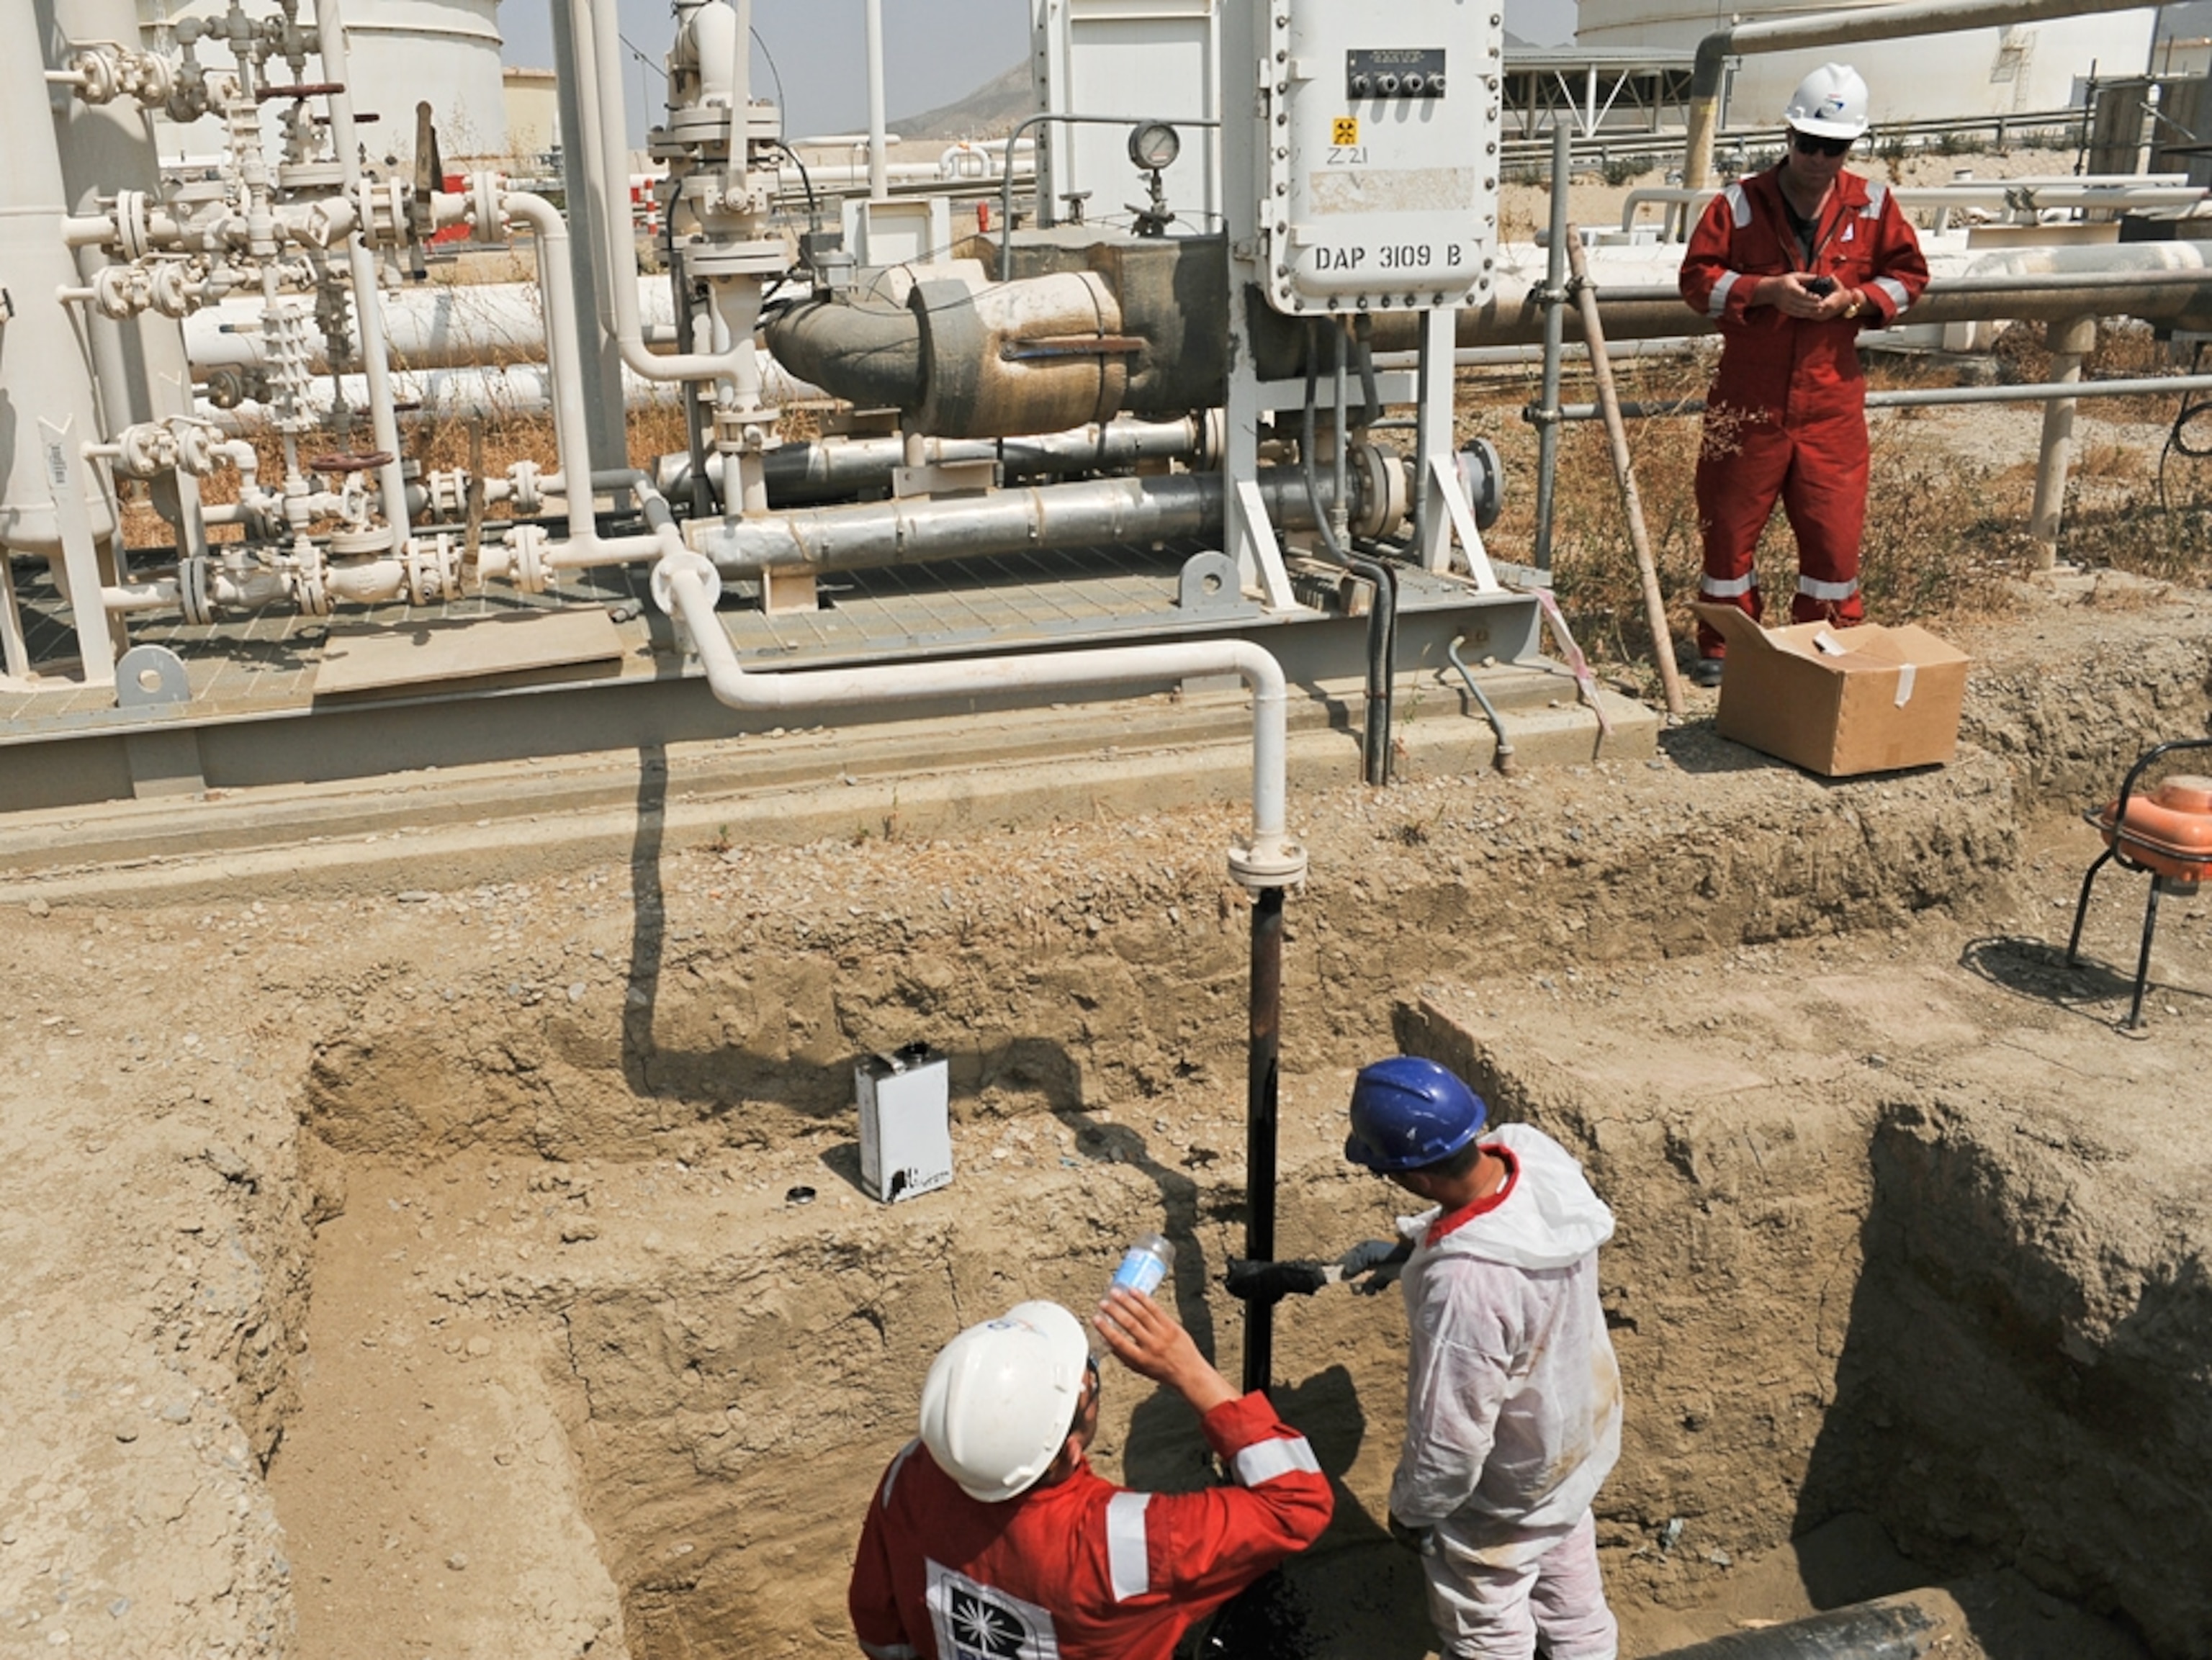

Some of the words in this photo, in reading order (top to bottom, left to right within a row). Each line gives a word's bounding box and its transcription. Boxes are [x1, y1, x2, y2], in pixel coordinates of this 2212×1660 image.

[1316, 246, 1365, 270] DAP
[1380, 244, 1431, 269] 3109
[1447, 243, 1462, 266] B
